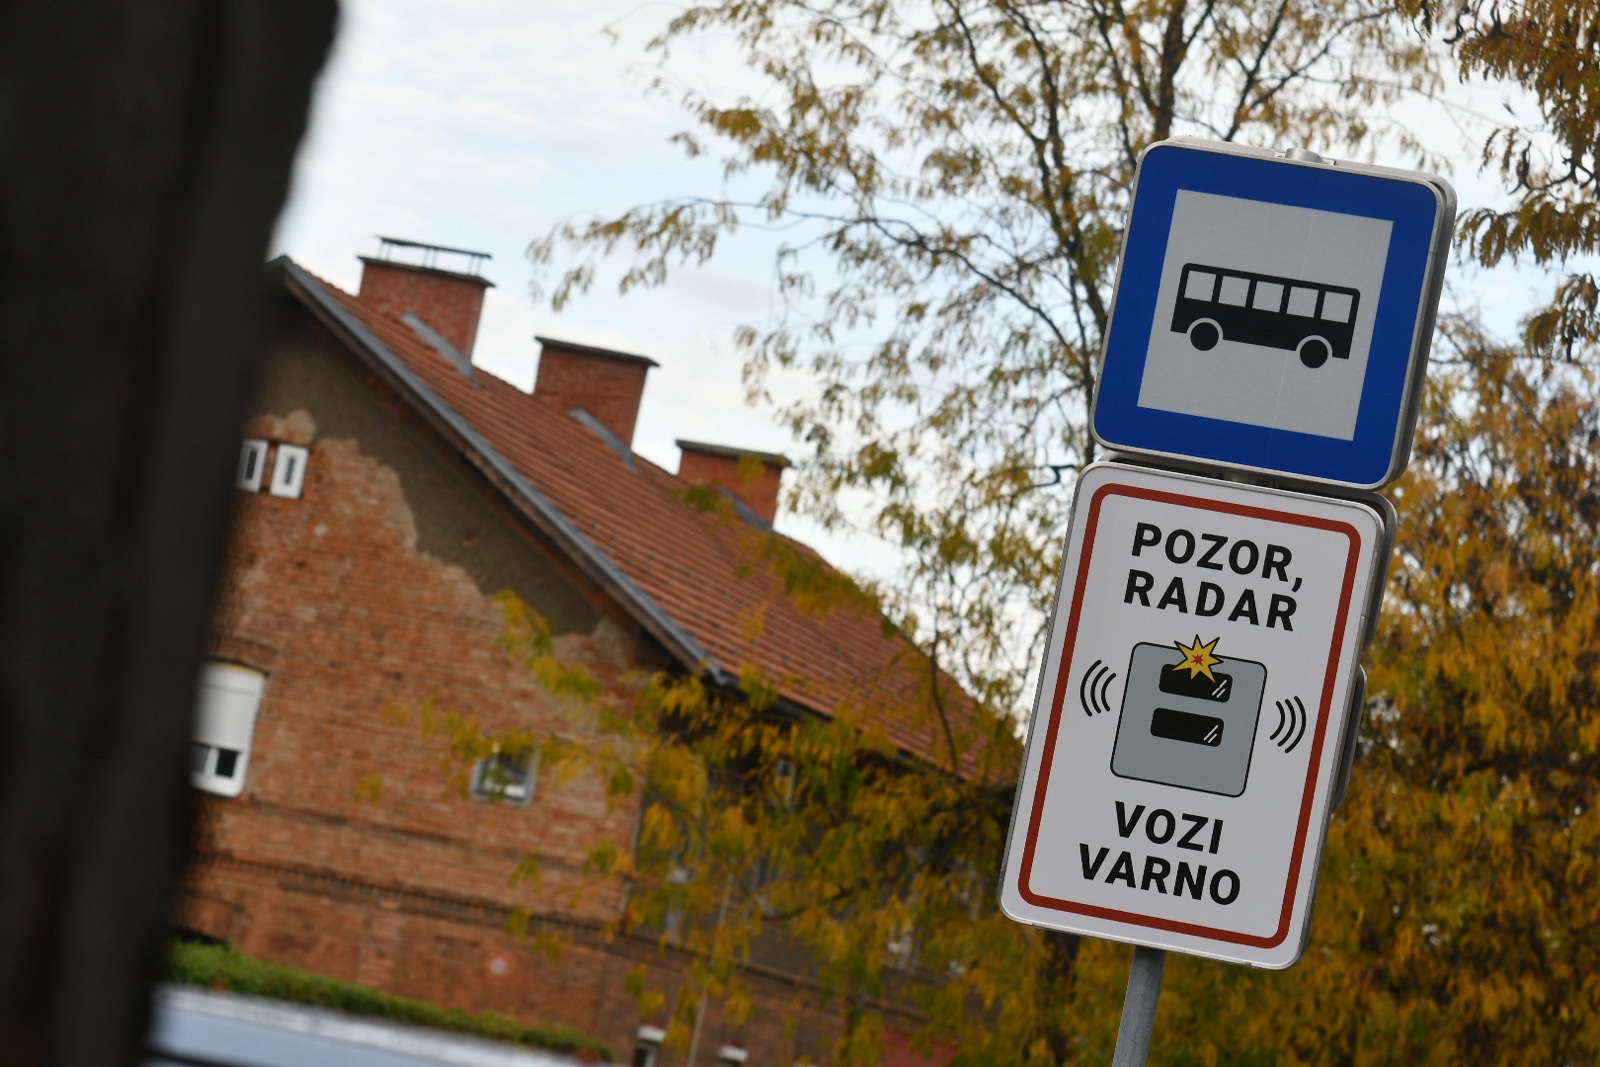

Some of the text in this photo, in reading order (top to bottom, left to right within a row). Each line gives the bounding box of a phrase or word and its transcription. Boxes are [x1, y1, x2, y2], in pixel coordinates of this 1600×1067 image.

[1131, 521, 1304, 593] POZOR,
[1123, 568, 1298, 632] RADAR
[1114, 800, 1224, 855] VOZI
[1079, 842, 1241, 906] VARNO
